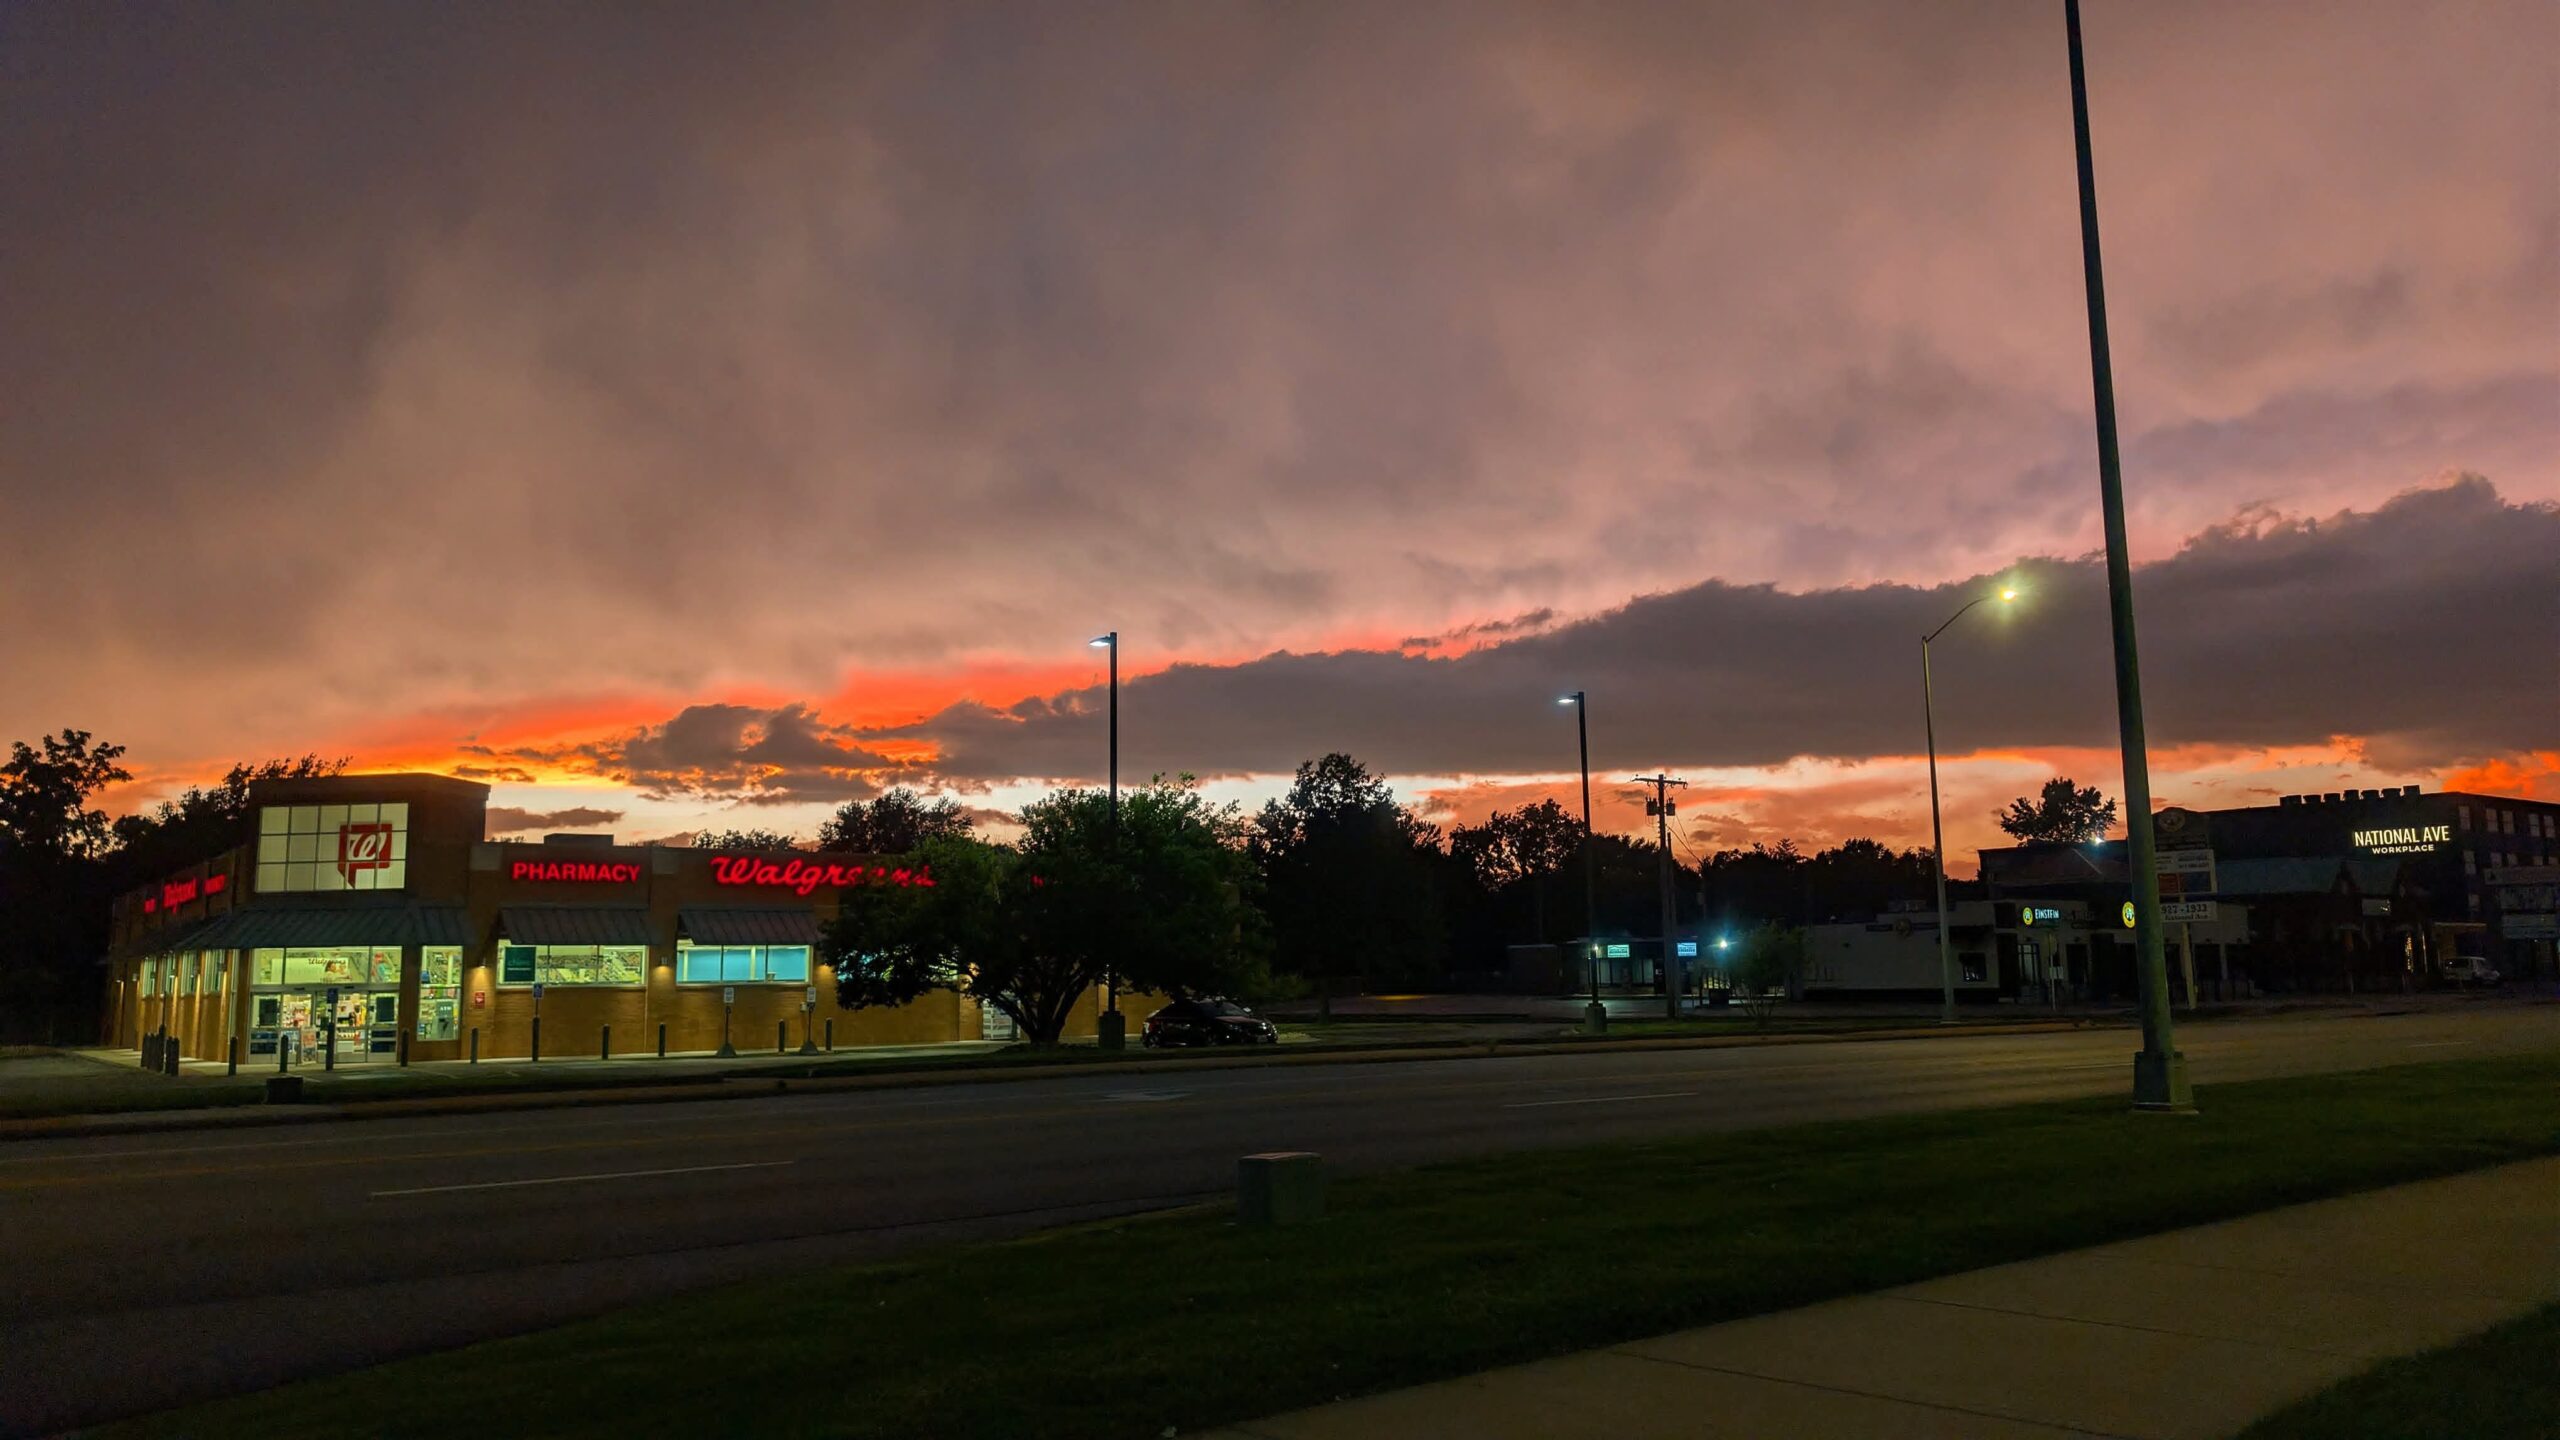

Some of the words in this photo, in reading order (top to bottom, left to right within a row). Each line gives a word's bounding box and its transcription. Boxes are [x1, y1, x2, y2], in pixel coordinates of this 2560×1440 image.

[2354, 827, 2420, 848] NATIONAL
[2422, 825, 2450, 842] AVE
[2371, 843, 2435, 855] WORKPLACE
[512, 861, 641, 882] PHARMACY
[2034, 908, 2059, 919] EINSTEIN
